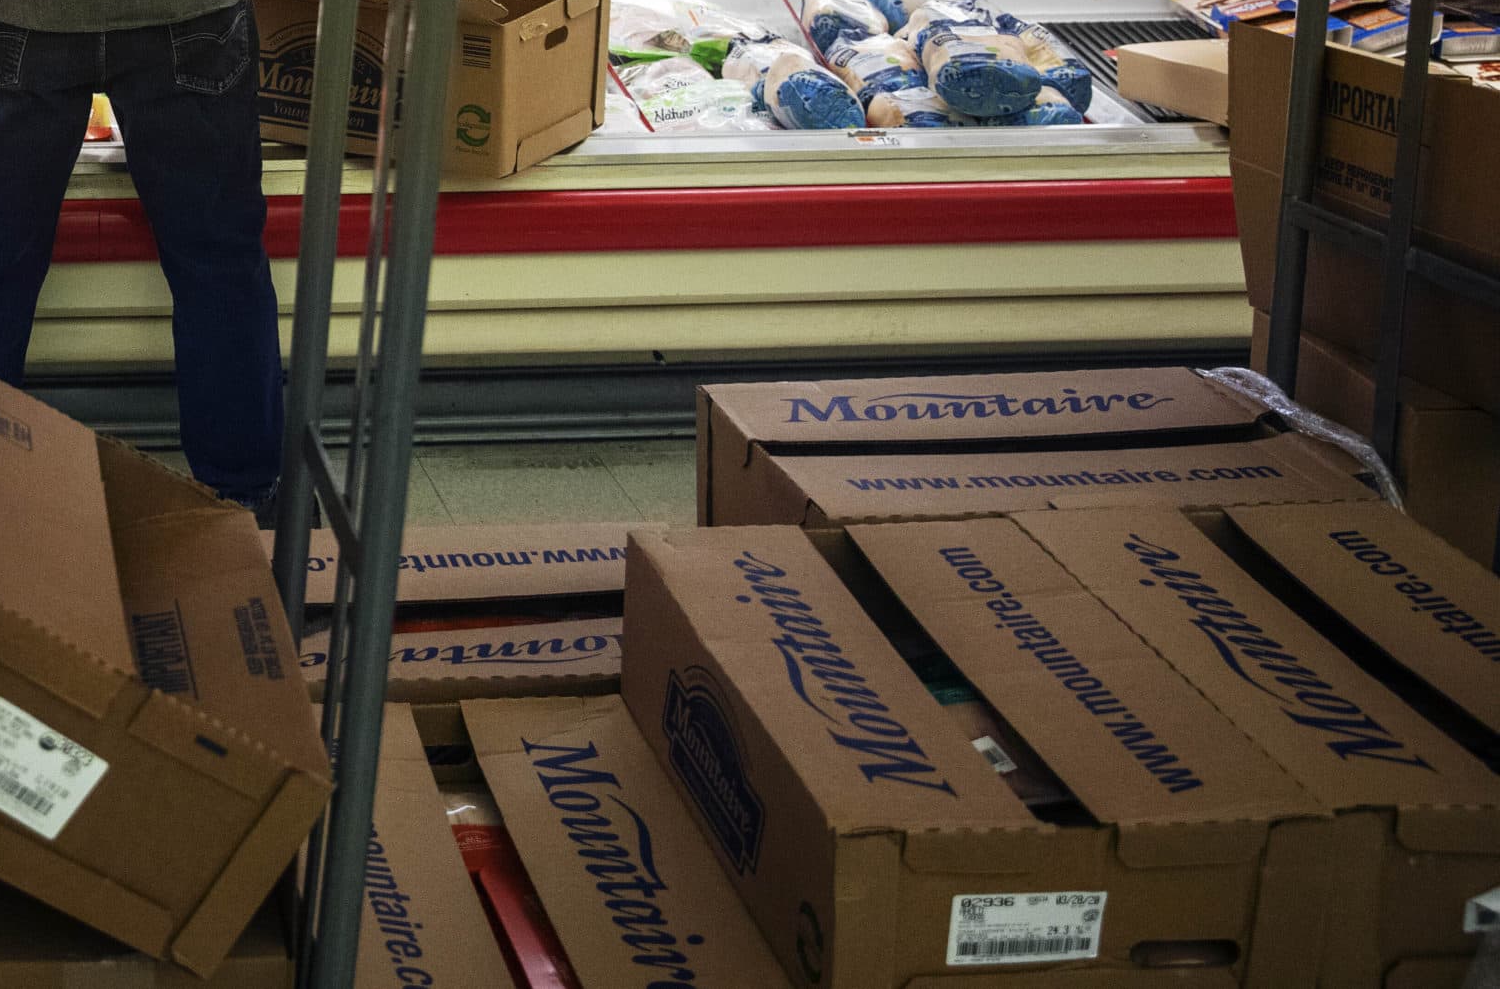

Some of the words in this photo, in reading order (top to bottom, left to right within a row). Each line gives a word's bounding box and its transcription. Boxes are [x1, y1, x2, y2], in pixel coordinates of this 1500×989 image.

[782, 388, 1175, 423] Mountaire
[847, 460, 1284, 494] www.mountaire.com
[1125, 532, 1439, 775] Mountaire
[1329, 529, 1500, 666] untaire.com
[731, 550, 958, 799] Mountaire
[937, 545, 1204, 795] www.mountaire.com
[671, 694, 752, 834] Mountaire
